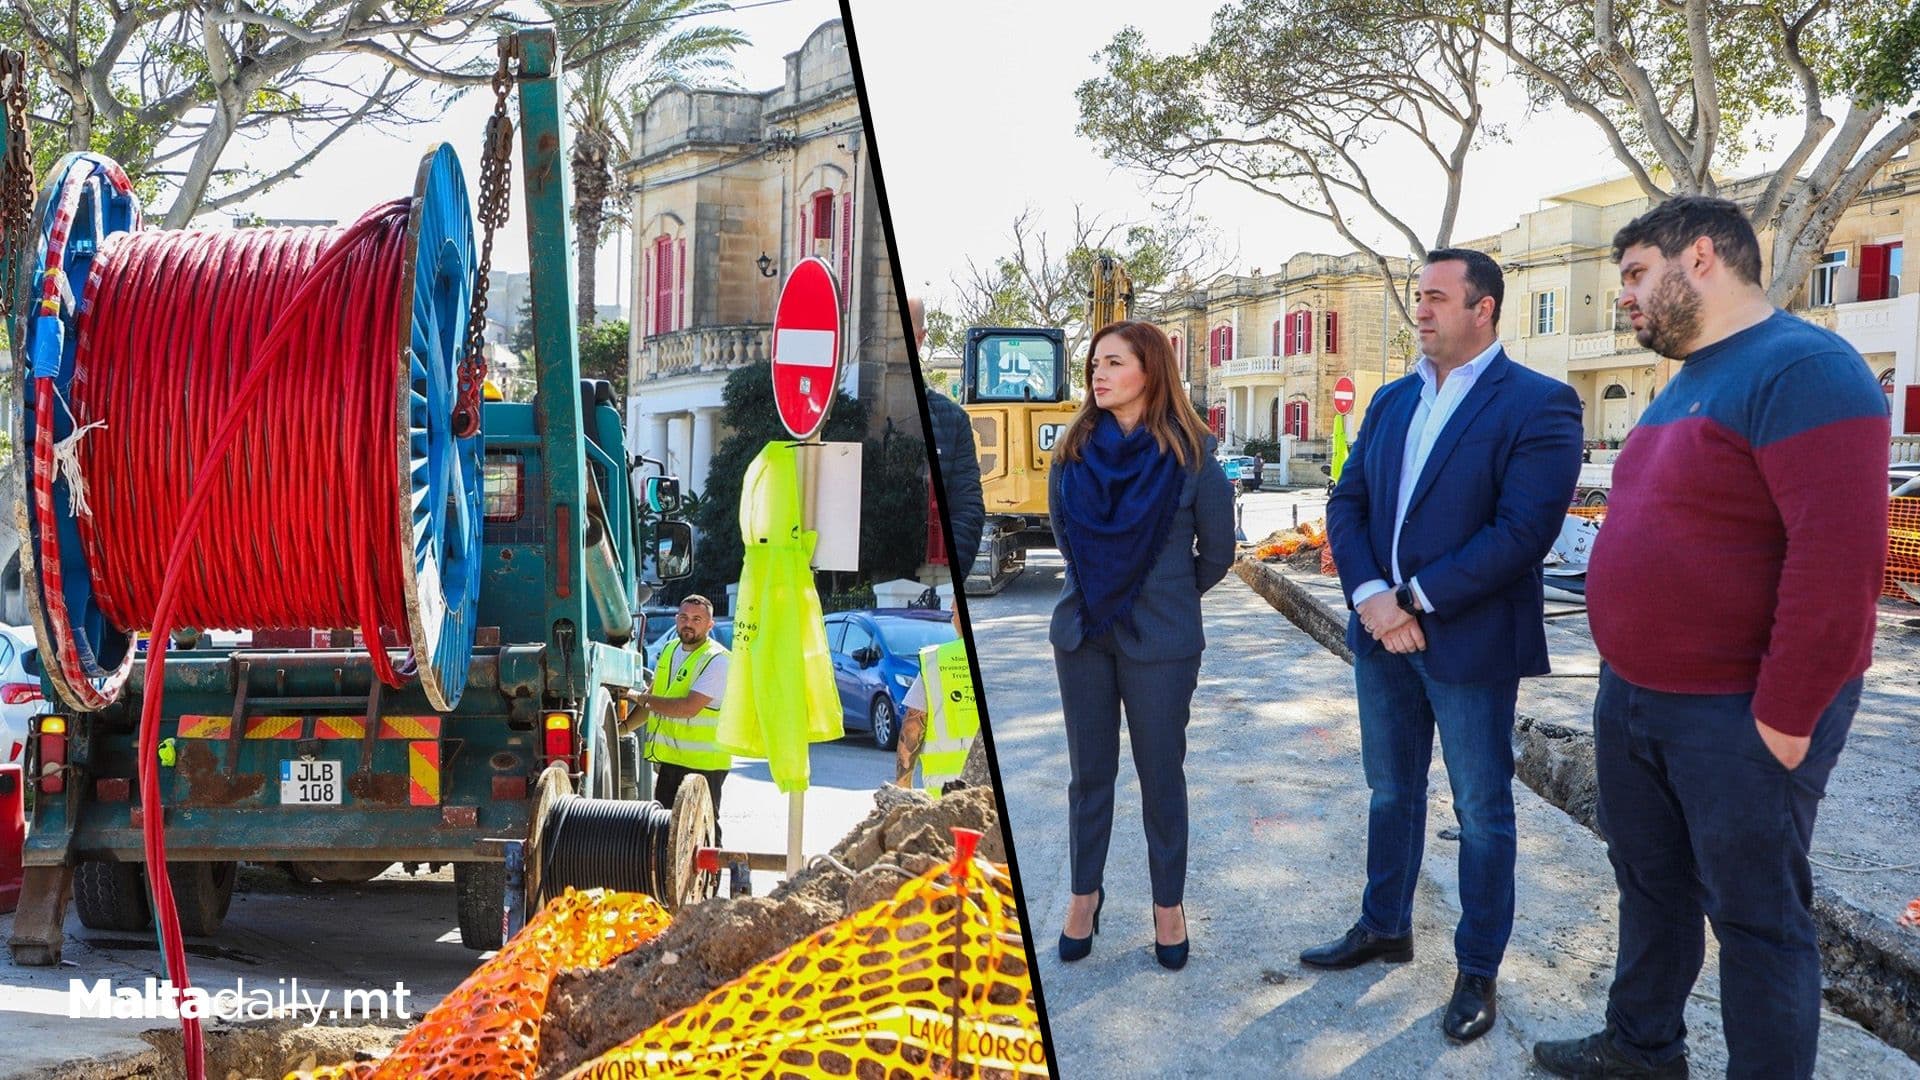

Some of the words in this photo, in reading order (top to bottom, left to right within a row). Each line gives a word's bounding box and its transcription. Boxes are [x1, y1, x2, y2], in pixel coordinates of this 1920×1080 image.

[297, 763, 334, 782] JLB
[299, 783, 334, 802] 108
[966, 1029, 1047, 1065] CORSO
